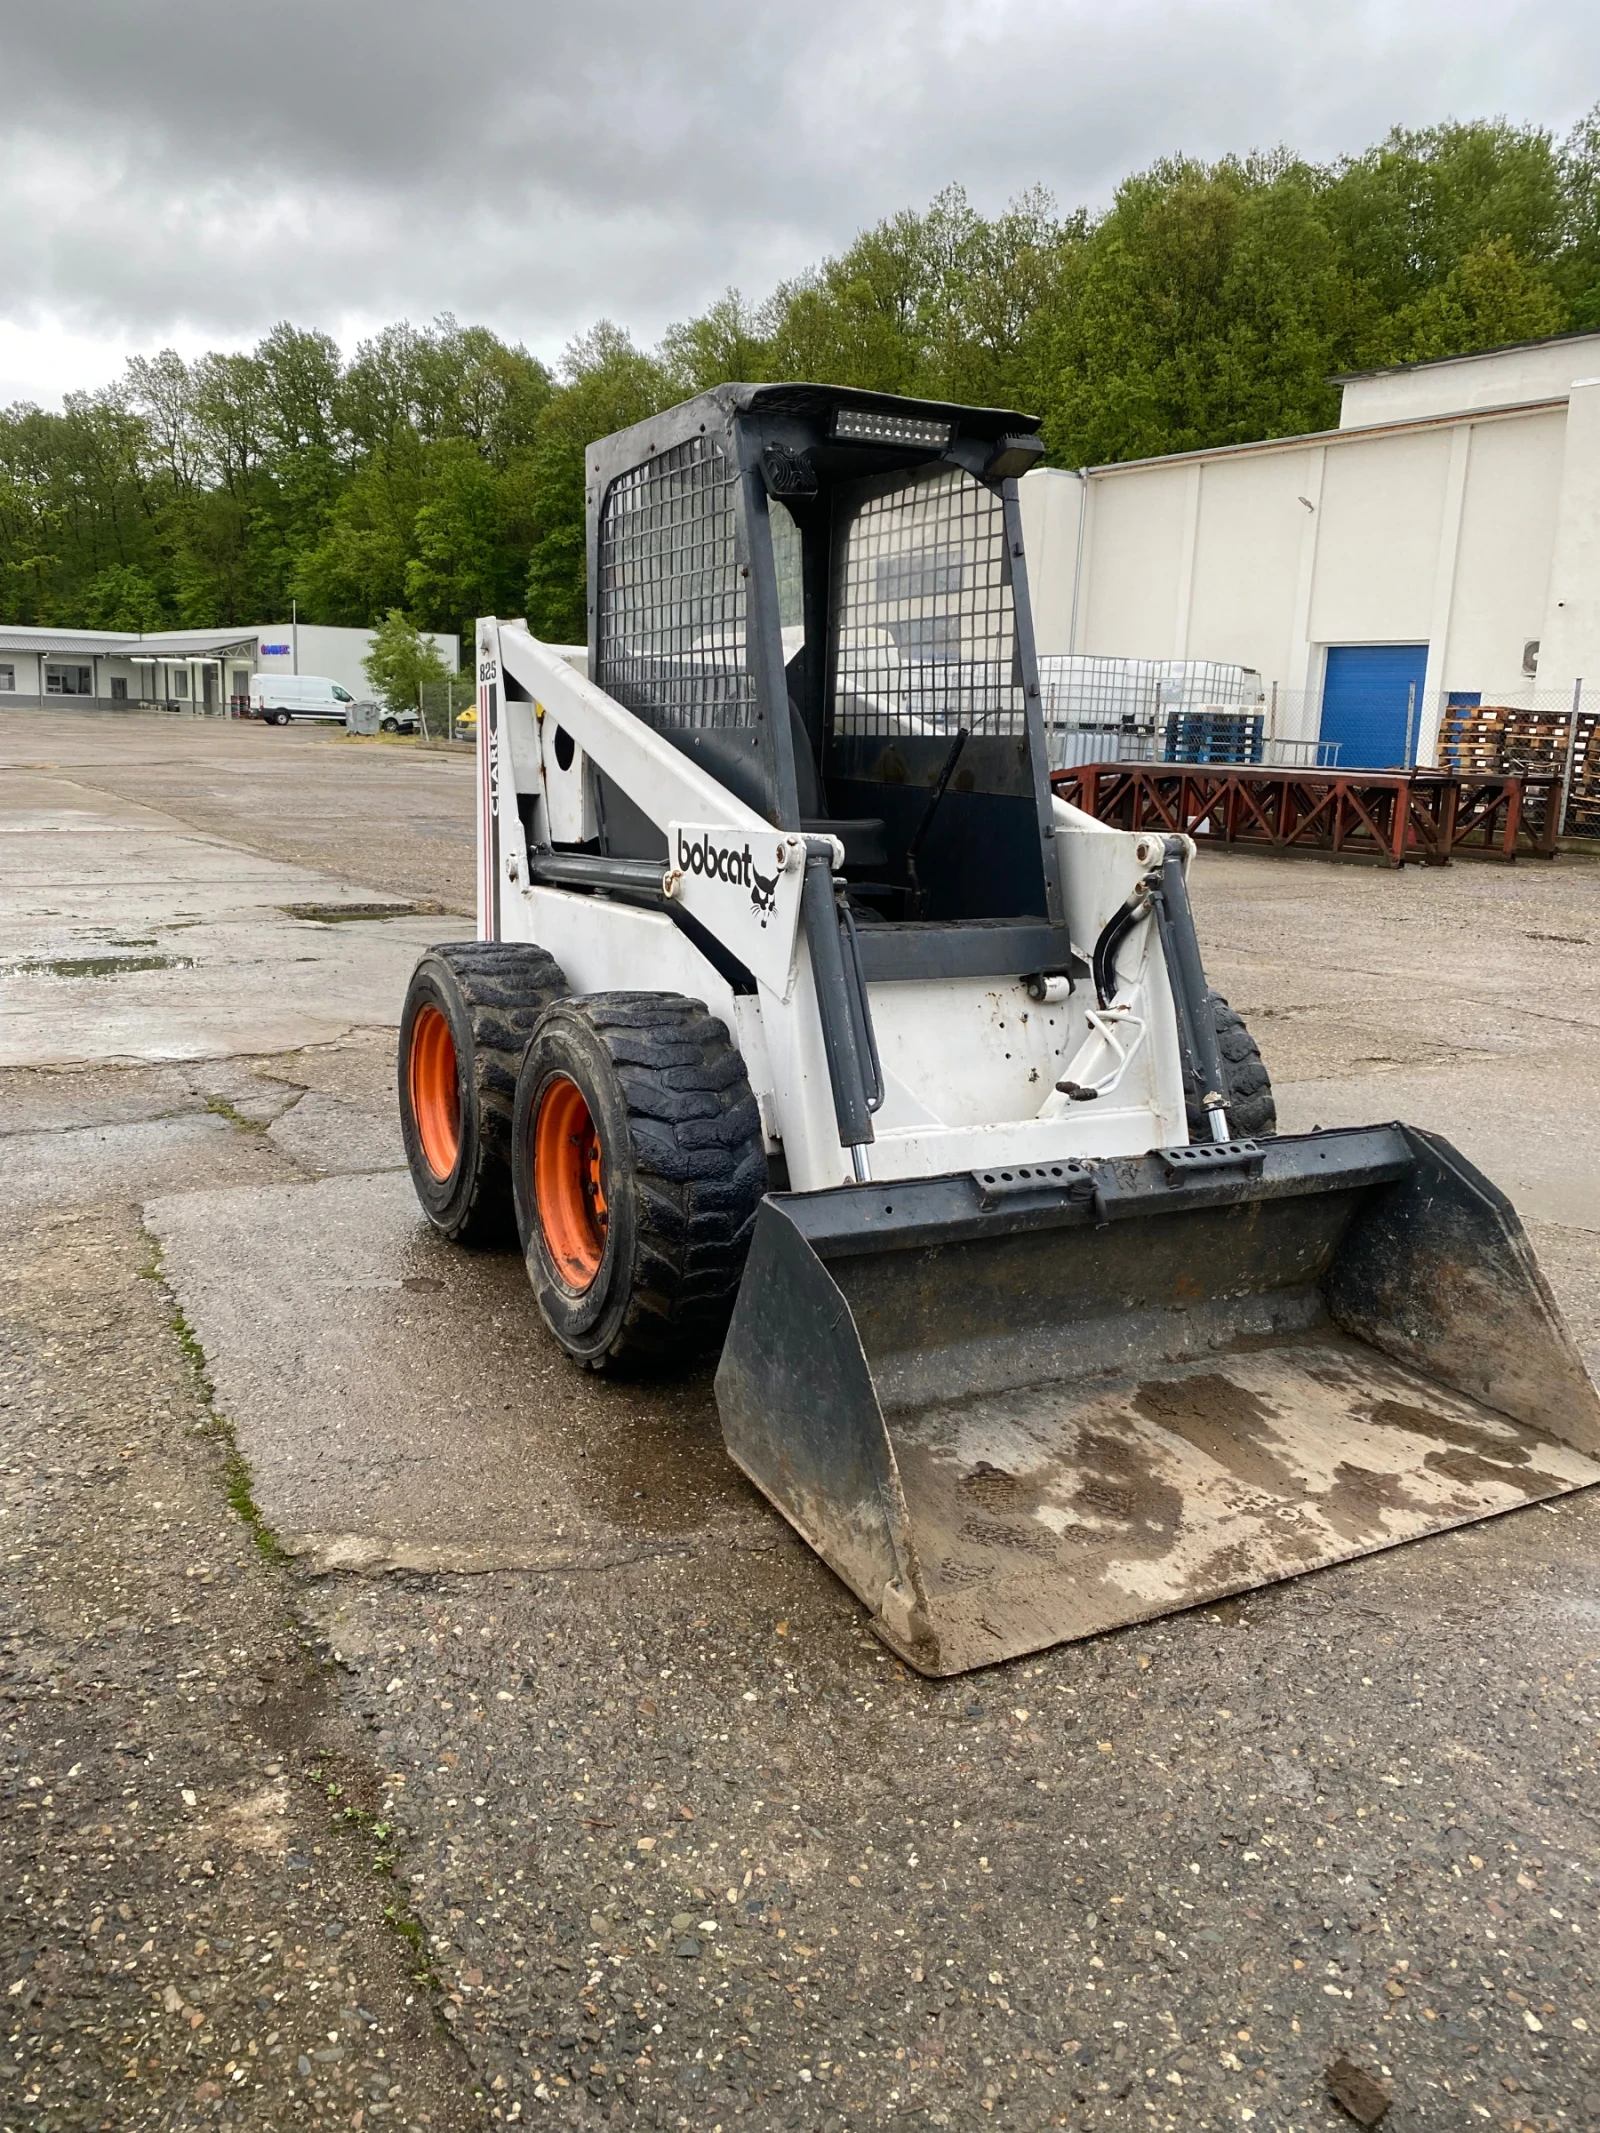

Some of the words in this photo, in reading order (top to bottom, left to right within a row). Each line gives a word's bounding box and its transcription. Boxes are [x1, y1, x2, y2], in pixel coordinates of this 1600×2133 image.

[480, 660, 496, 682] 825
[490, 727, 499, 816] CLARK
[678, 828, 752, 888] bobcat
